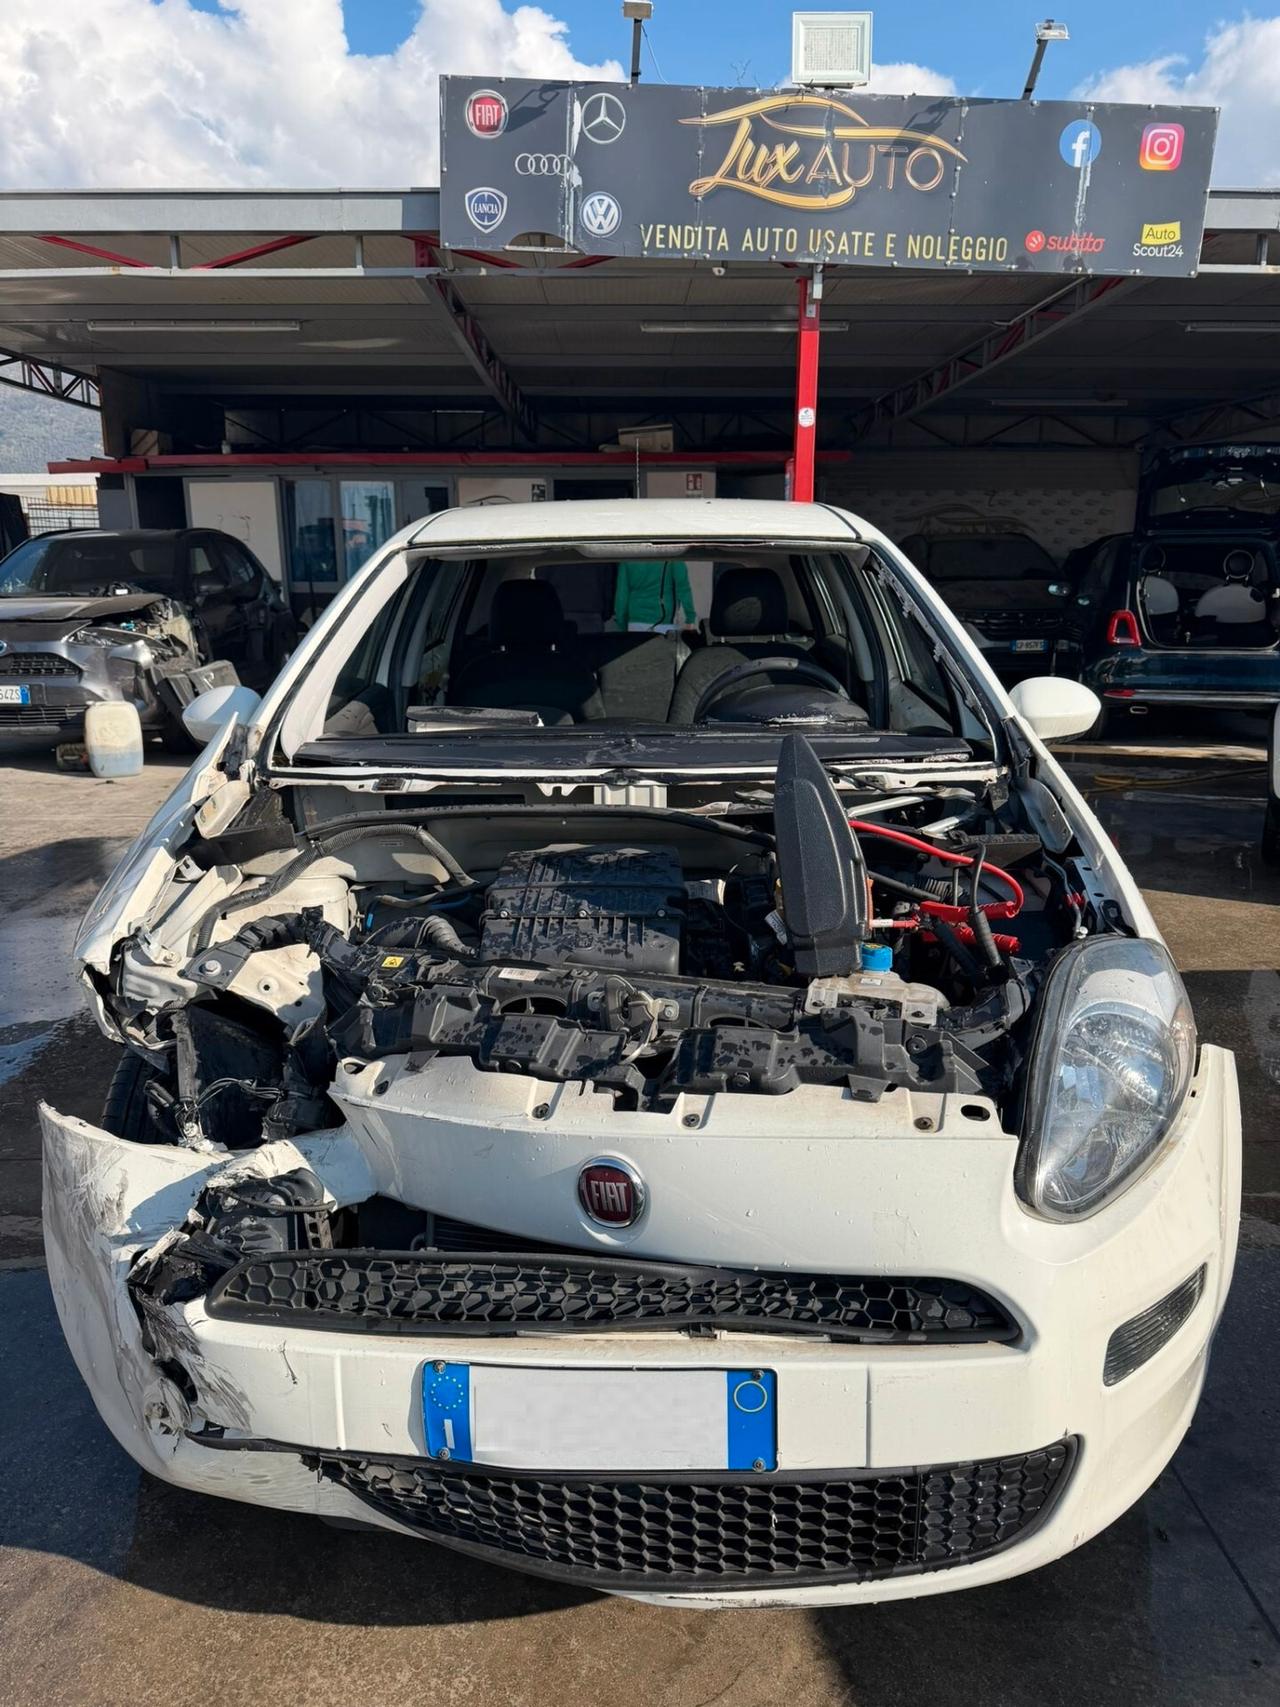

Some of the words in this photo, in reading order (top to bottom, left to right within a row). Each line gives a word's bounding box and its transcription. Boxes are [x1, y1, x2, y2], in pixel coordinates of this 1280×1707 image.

[475, 104, 500, 126] FIAT
[689, 117, 805, 198] Lux
[806, 142, 945, 192] AUTO
[474, 203, 499, 214] LANCIA
[640, 224, 729, 251] VENDITA
[742, 227, 798, 253] AUTO
[808, 228, 875, 256] USATE
[885, 233, 896, 257] E
[907, 234, 1008, 261] NOLEGGIO
[1046, 231, 1105, 252] subito
[1144, 227, 1176, 241] Auto
[1132, 243, 1184, 258] Scout24
[590, 1180, 628, 1212] FIAT
